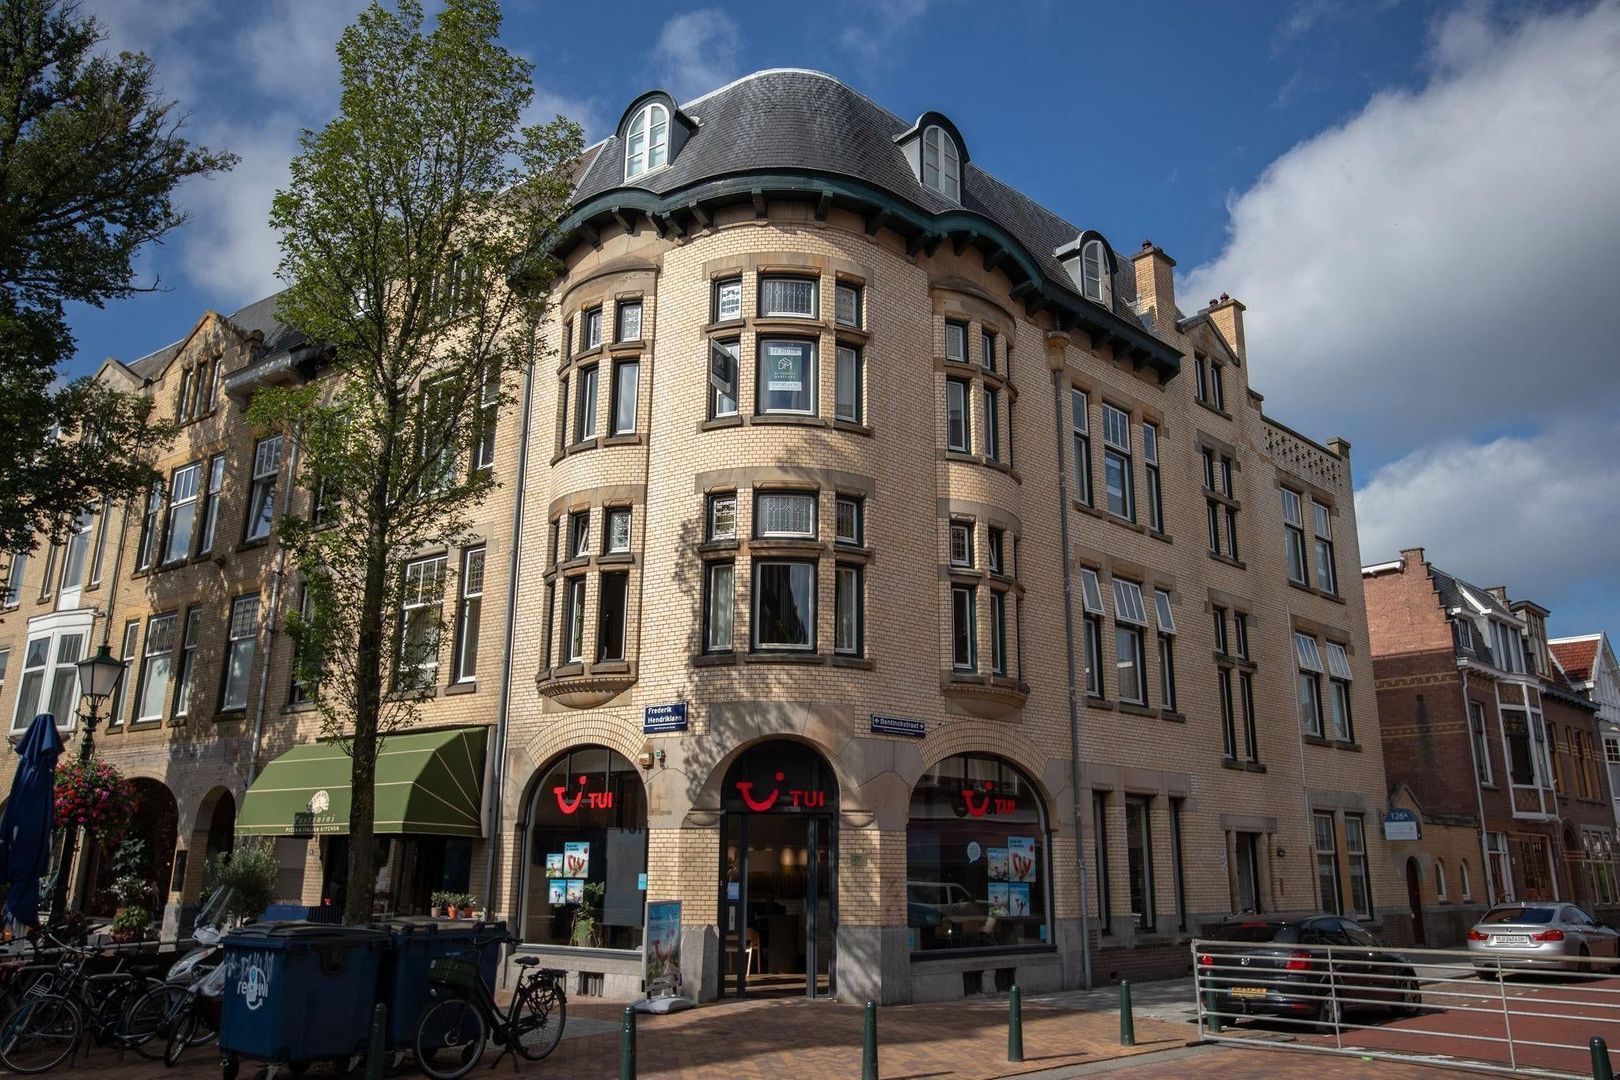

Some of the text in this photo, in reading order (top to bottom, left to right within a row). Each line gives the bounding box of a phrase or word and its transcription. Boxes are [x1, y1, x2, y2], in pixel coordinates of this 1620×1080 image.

[647, 715, 683, 723] Hendriklaan
[880, 718, 920, 729] Bentinckstraat
[589, 792, 613, 808] TUI
[789, 790, 824, 808] TUI
[995, 799, 1016, 816] TUI
